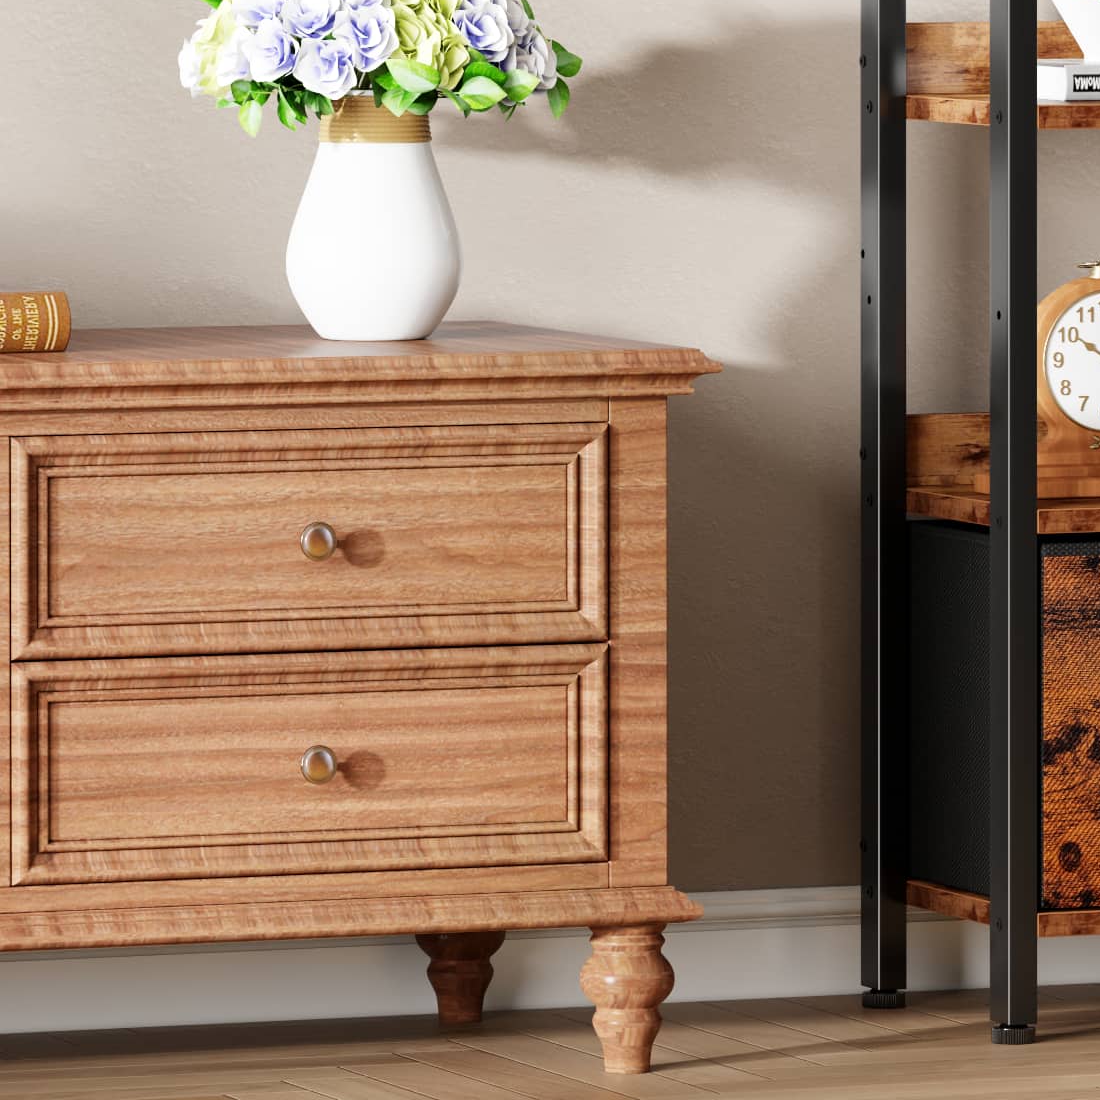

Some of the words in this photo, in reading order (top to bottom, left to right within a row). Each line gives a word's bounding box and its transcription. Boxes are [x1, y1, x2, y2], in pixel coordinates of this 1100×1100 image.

[1074, 75, 1100, 92] MoMA
[1076, 306, 1095, 323] 11
[1057, 326, 1079, 343] 10
[1053, 352, 1065, 368] 9
[1060, 379, 1071, 396] 8
[1078, 395, 1089, 412] 7
